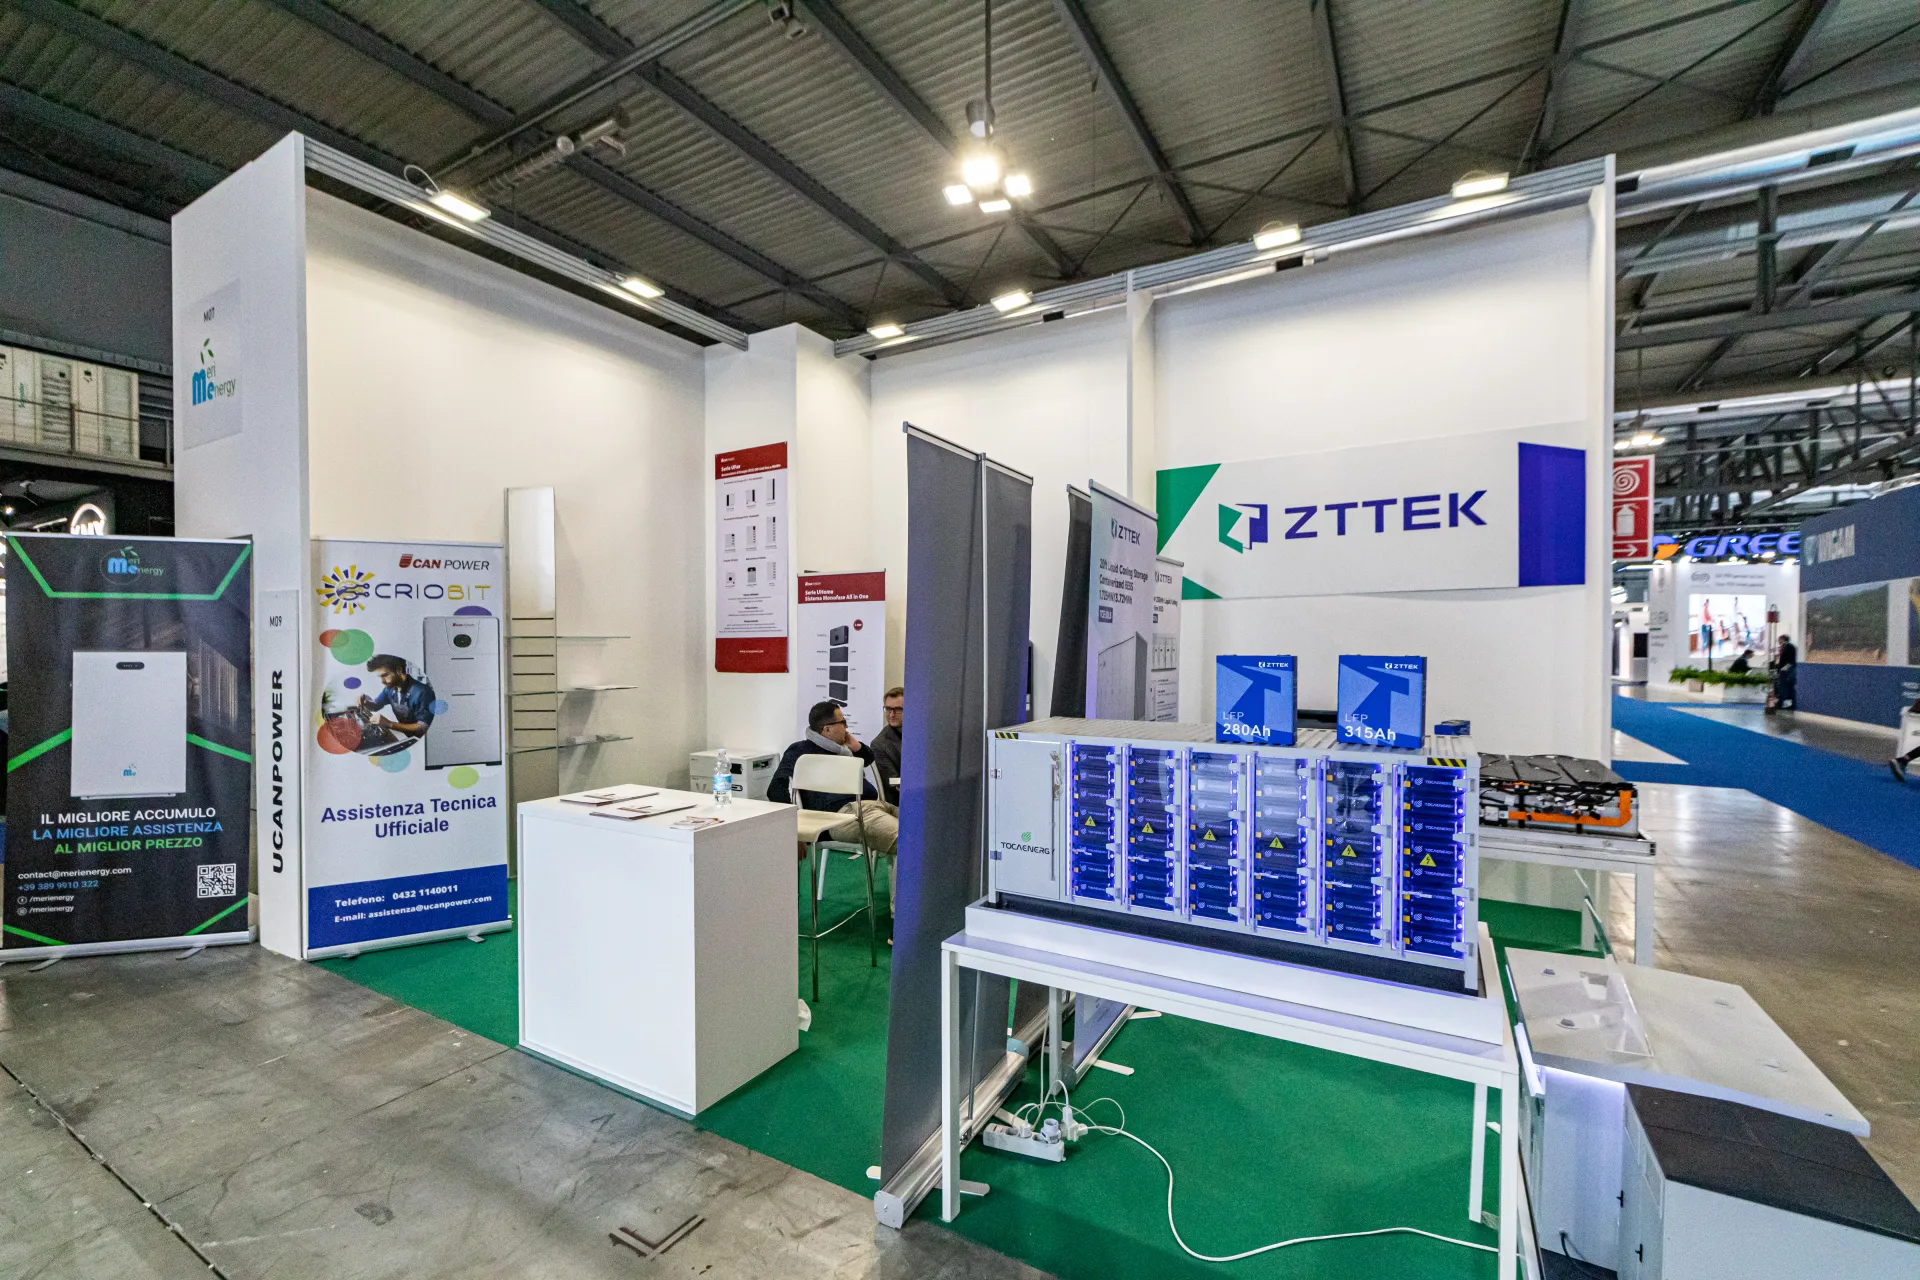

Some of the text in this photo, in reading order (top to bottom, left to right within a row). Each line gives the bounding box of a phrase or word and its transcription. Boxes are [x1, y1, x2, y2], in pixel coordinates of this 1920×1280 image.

[1285, 490, 1487, 540] ZTTEK
[1118, 525, 1141, 545] ZTTEK
[1684, 531, 1800, 558] GREE
[443, 560, 490, 571] POWER
[374, 583, 491, 600] CRIOBIT
[269, 616, 283, 627] M09
[1222, 711, 1244, 721] LFP
[1345, 713, 1369, 723] LFP
[1222, 723, 1271, 737] 280Ah
[1344, 725, 1396, 741] 315Ah
[272, 669, 284, 874] UCANPOWER
[41, 807, 216, 825] IL MIGLIORE ACCUMULO
[321, 795, 497, 823] Assistenza Tecnica
[33, 822, 224, 841] LA MIGLIORE ASSISTENZA
[375, 818, 449, 838] Ufficiale
[54, 837, 203, 855] AL MIGLIOR PREZZO
[18, 867, 132, 880] contact@merienergy.com
[38, 881, 55, 891] 389
[56, 880, 79, 890] 9910
[81, 879, 99, 888] 322
[29, 894, 74, 903] /merienergy
[334, 884, 458, 908] Telefono: 0432 1140011
[29, 905, 74, 914] /merienergy
[334, 895, 492, 923] E-mail: assistenza@ucanpower.com
